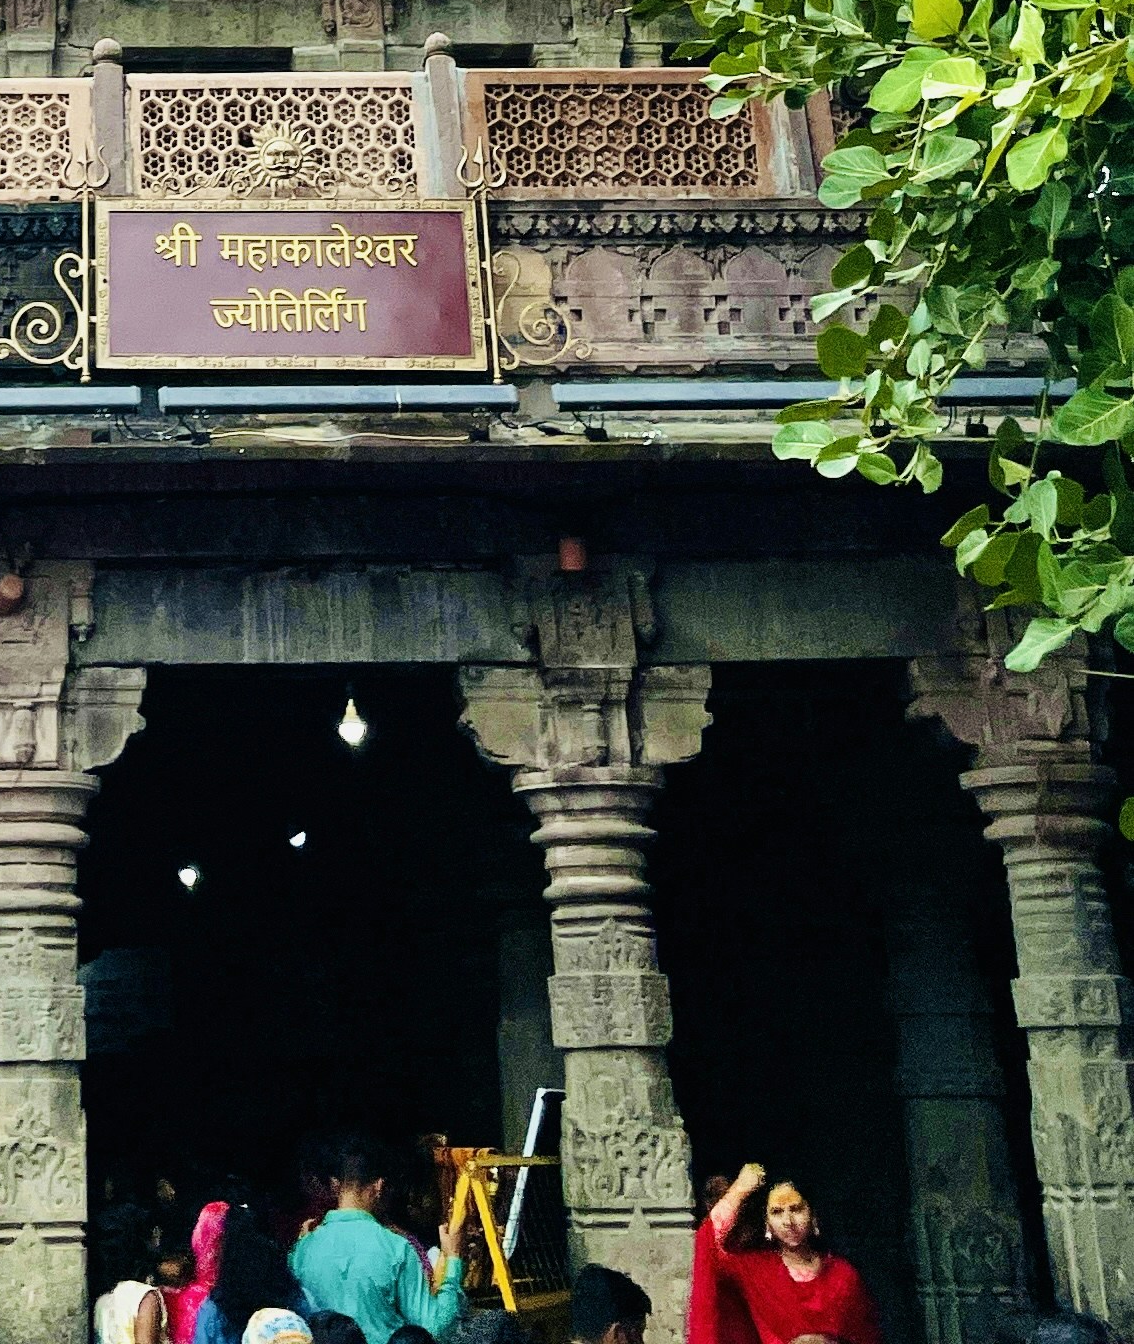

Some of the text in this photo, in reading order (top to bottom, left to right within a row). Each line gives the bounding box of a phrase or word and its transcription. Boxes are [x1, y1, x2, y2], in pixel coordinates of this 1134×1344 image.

[153, 222, 419, 272] श्री महाकालेश्वर
[209, 287, 368, 333] ज्योतिर्लिंग
